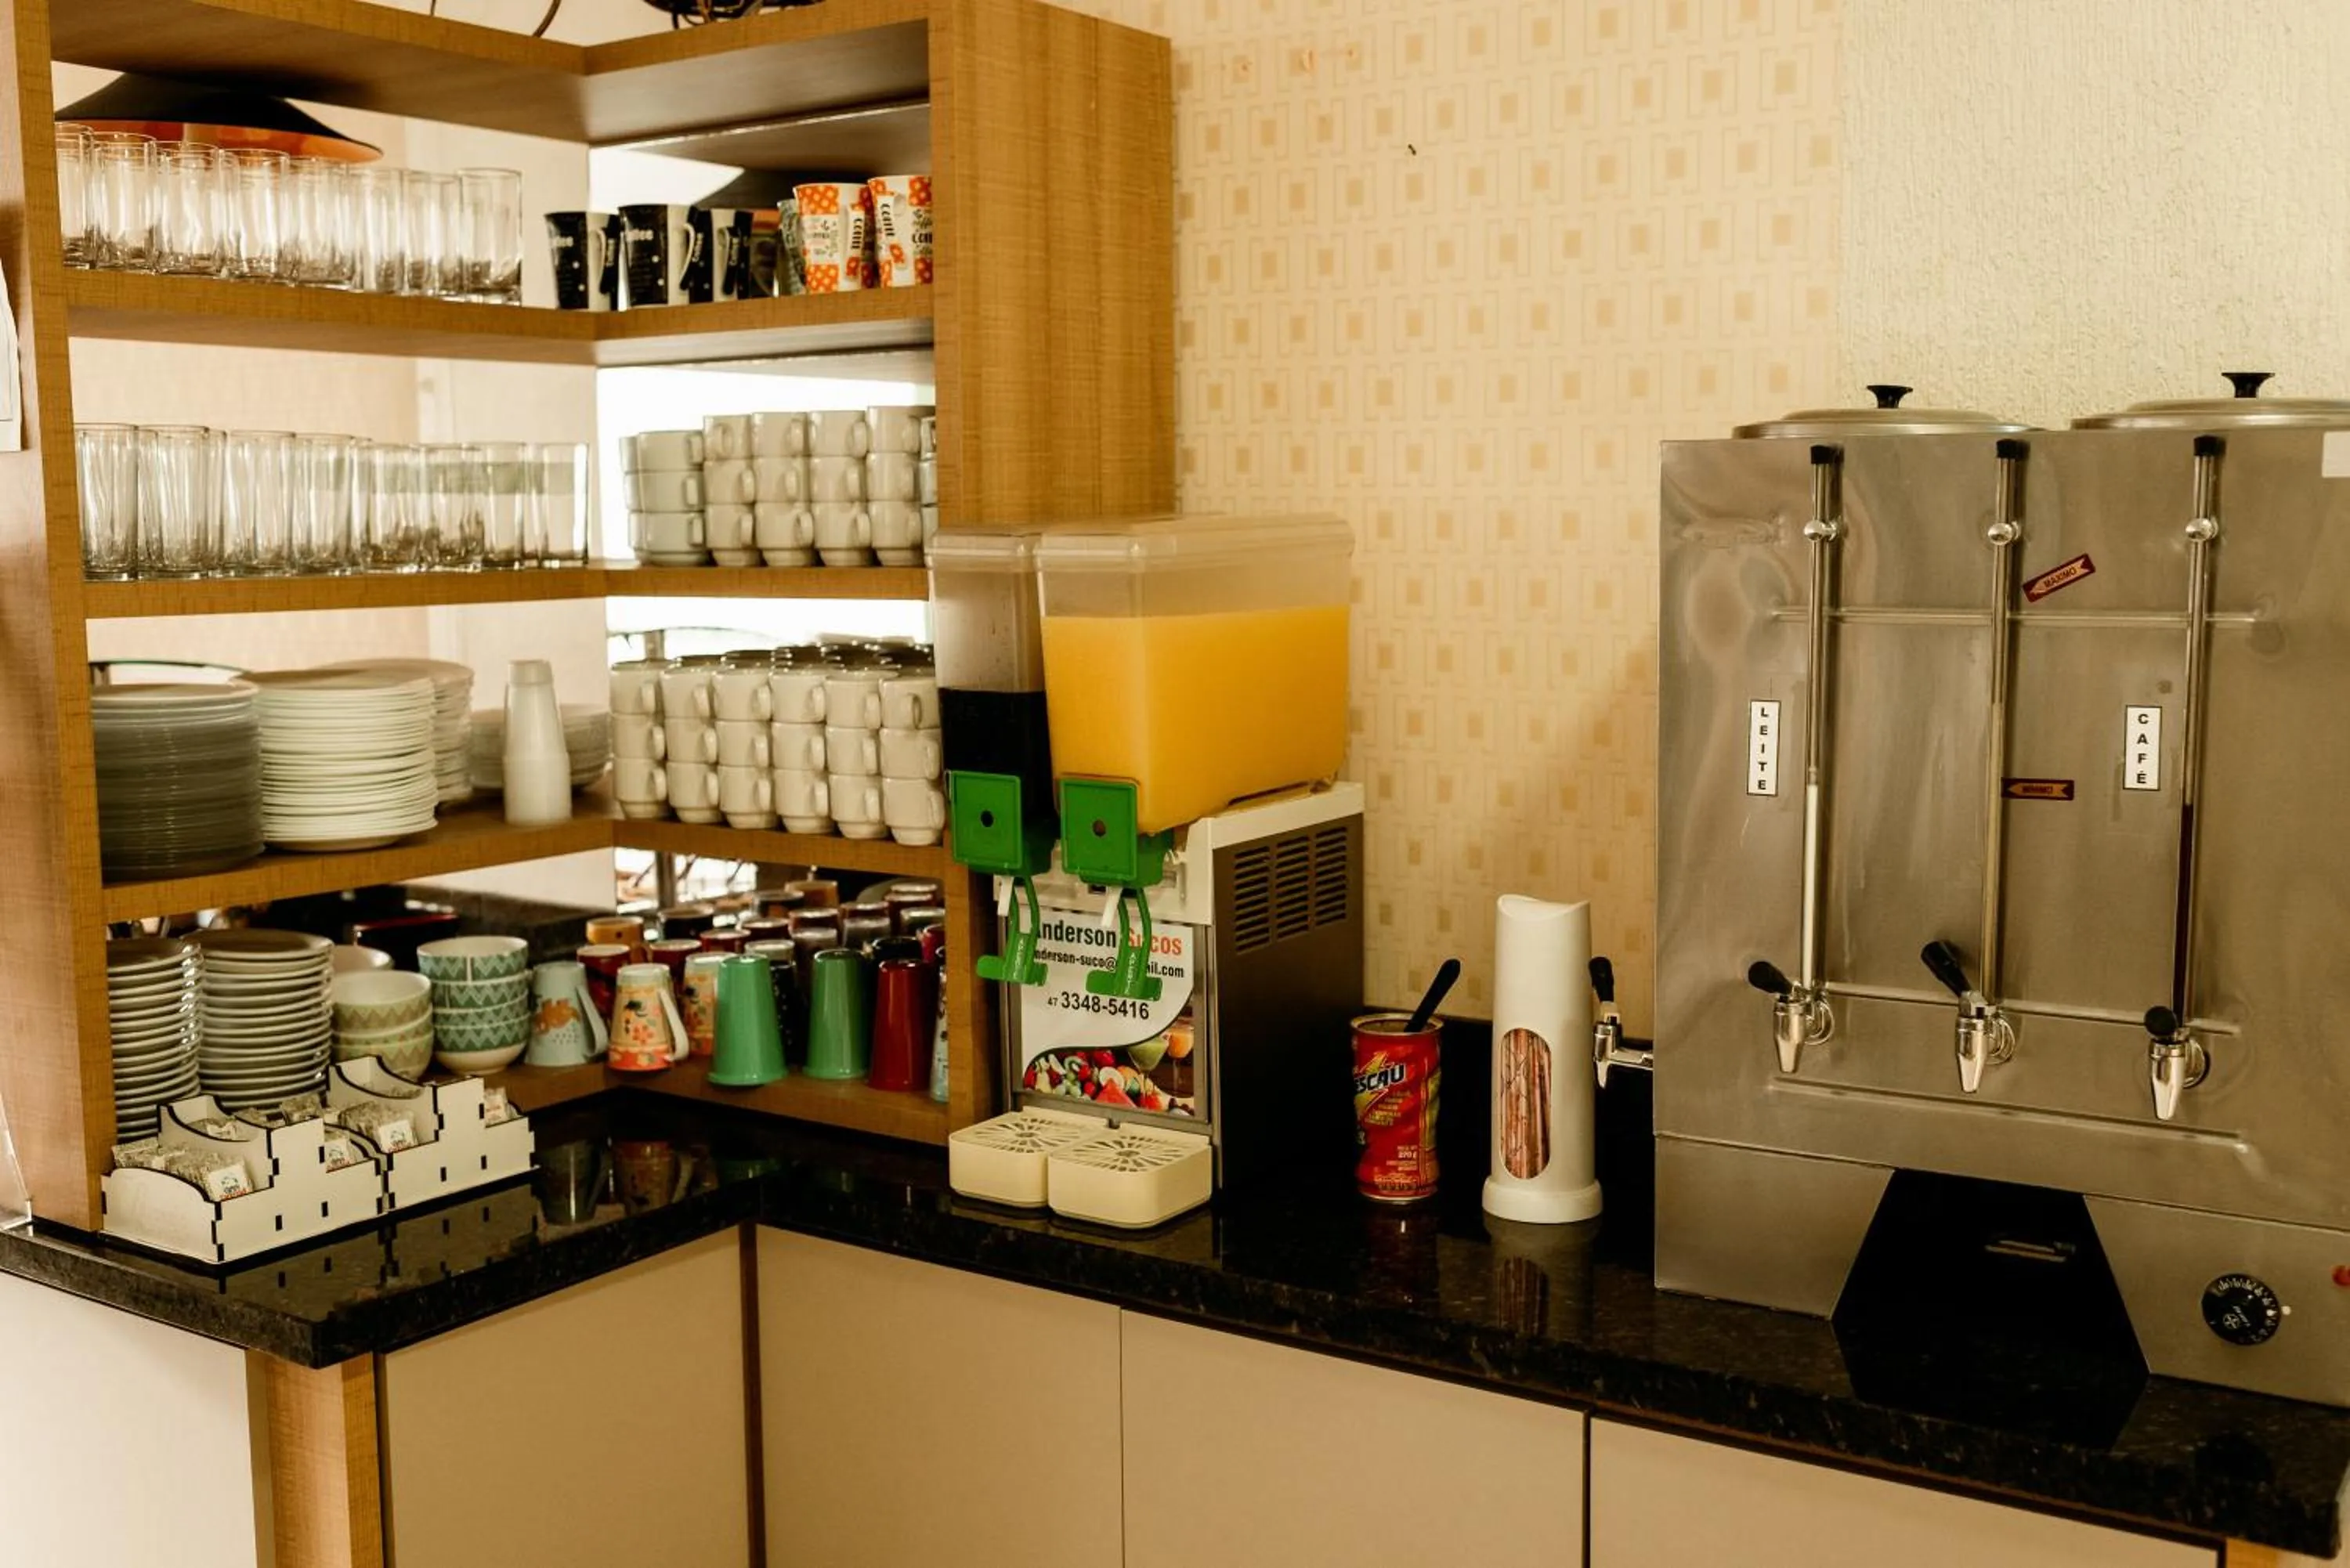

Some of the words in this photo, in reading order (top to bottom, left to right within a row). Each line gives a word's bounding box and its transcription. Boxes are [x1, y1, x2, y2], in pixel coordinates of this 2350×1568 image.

[1757, 706, 1770, 790] LEITE
[2136, 713, 2149, 785] CAFÉ
[1037, 919, 1117, 948] nderson
[1047, 996, 1058, 1007] 47
[1061, 991, 1150, 1020] 3348-5416
